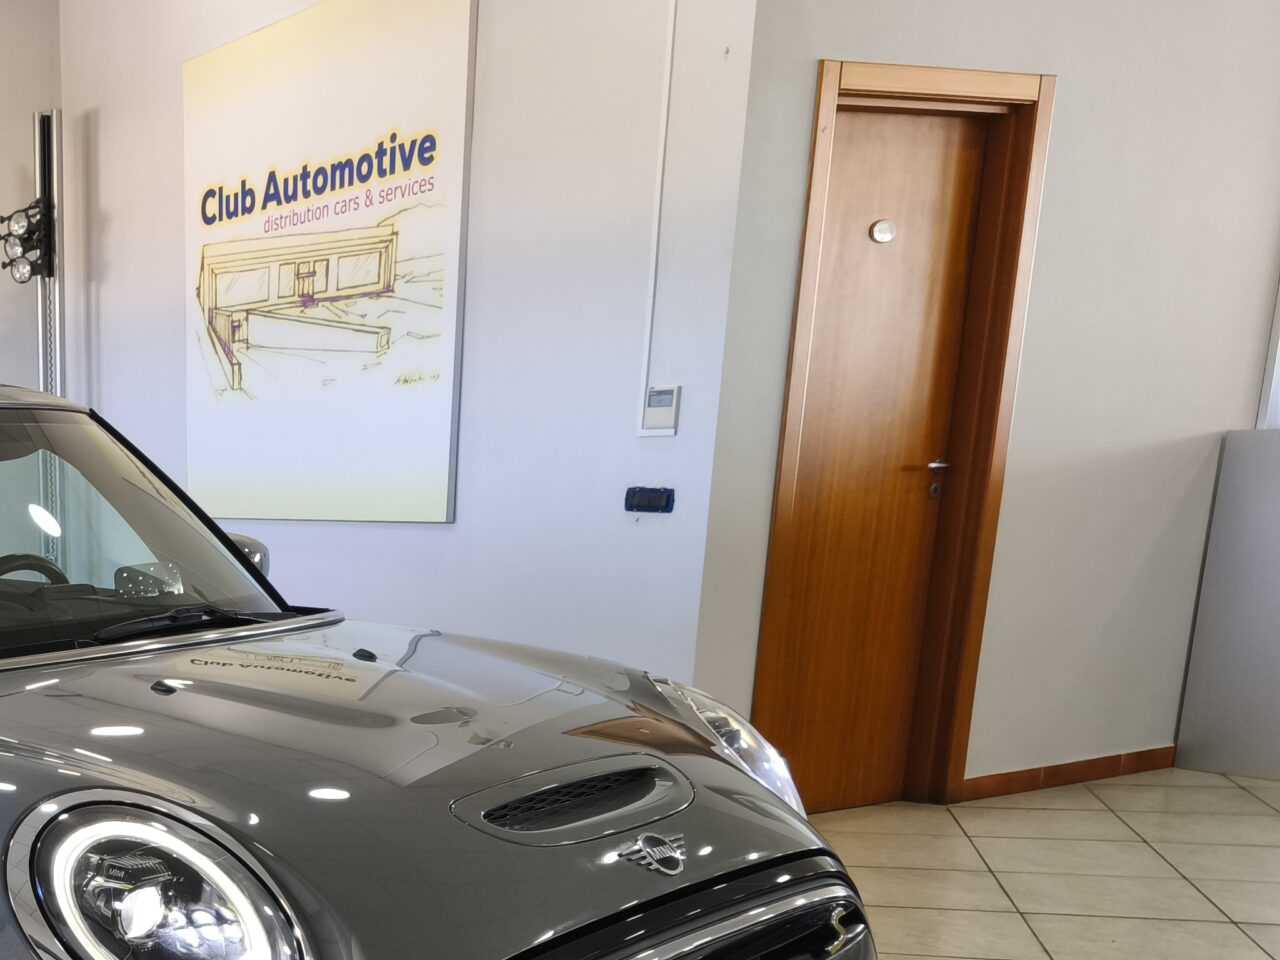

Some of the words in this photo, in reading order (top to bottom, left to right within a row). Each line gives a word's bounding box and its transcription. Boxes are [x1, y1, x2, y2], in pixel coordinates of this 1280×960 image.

[201, 179, 256, 226] Club
[261, 133, 437, 211] Automotive
[263, 203, 329, 233] distribution
[333, 193, 360, 216] cars
[364, 189, 375, 208] &
[378, 175, 435, 205] services
[647, 844, 675, 861] MINI
